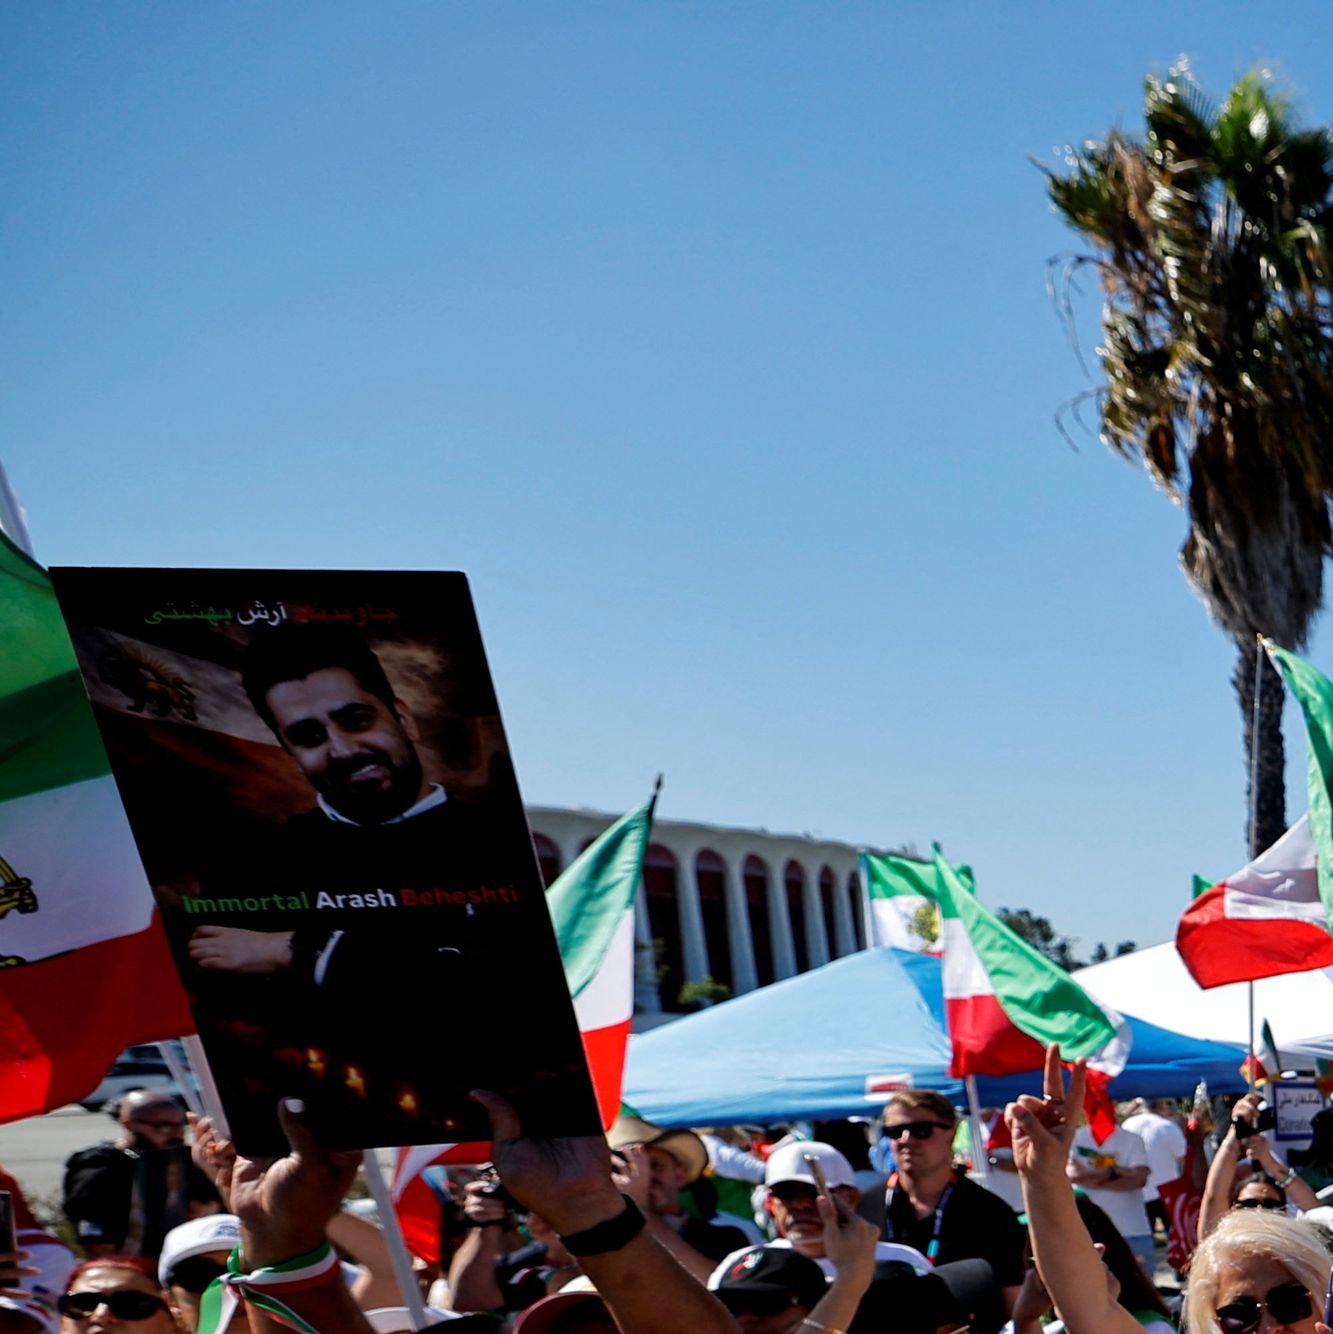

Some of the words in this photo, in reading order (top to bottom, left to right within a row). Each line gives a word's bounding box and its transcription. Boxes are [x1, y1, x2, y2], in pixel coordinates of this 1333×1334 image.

[237, 600, 288, 626] آرش
[182, 892, 310, 913] Immortal
[316, 889, 398, 909] Arash
[400, 885, 518, 906] Beheshti
